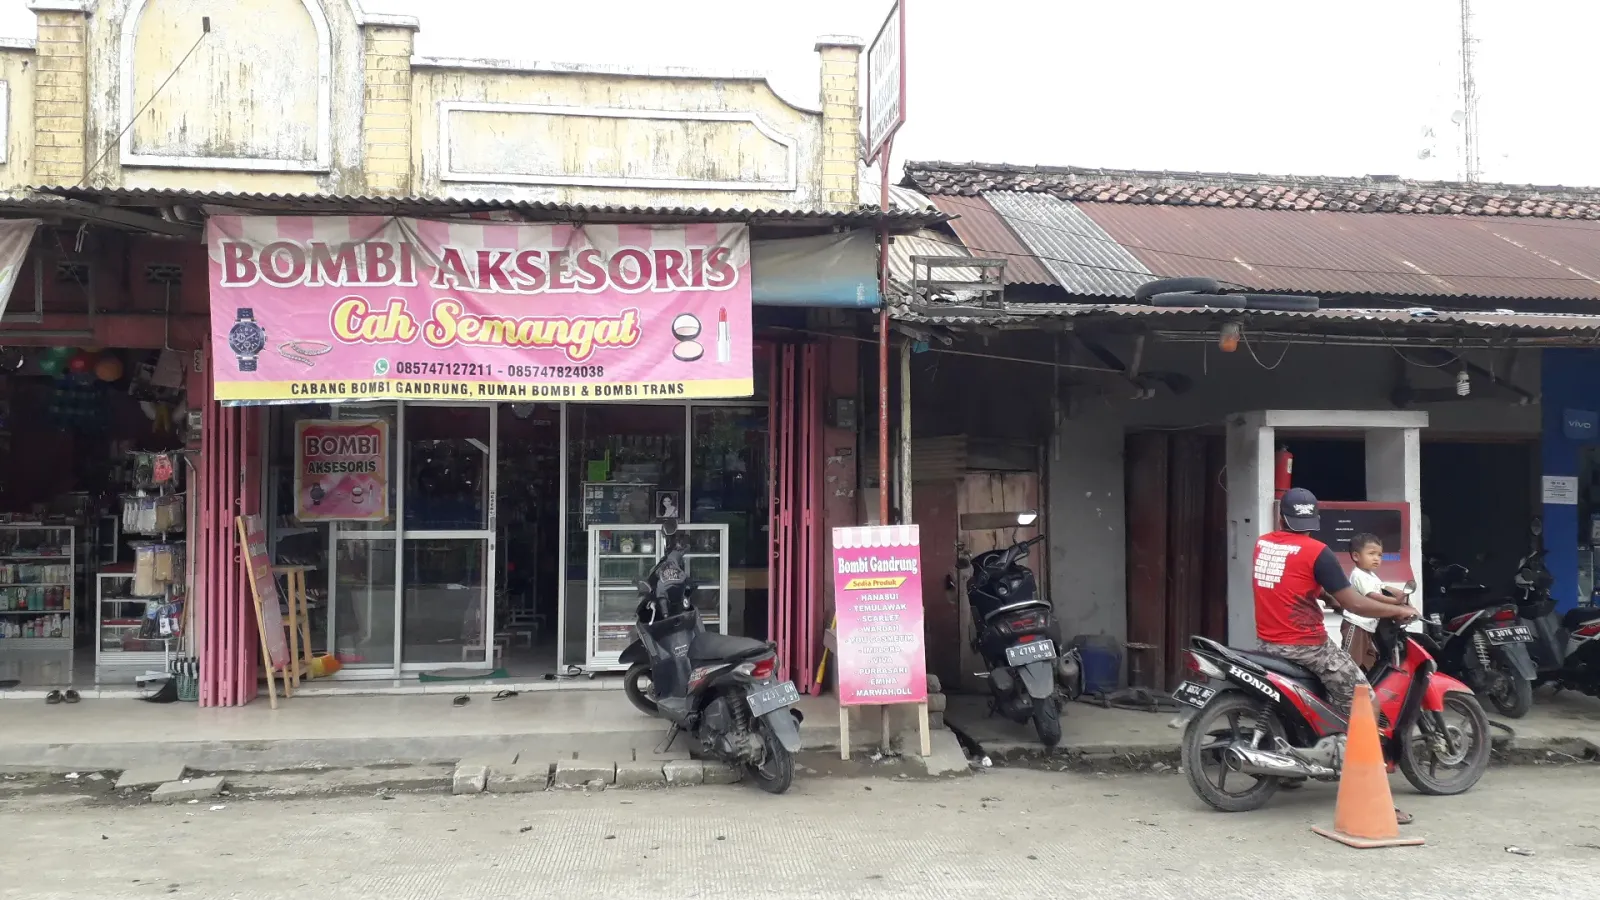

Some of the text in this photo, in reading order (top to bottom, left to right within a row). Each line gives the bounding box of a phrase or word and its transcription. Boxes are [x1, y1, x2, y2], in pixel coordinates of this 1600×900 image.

[221, 240, 738, 292] BOMBI AKSESORIS
[332, 297, 639, 360] Cah Semangat
[396, 362, 492, 376] 085747127211
[507, 364, 604, 378] 085747824038
[291, 382, 685, 397] CABANG BOMBI GANDRUNG, RUMAH BOMBI & BOMBI TRANS
[1568, 420, 1591, 429] vivo
[305, 434, 379, 457] BOMBI
[307, 460, 377, 474] AKSESORIS
[838, 556, 918, 575] Bombi Gandrung
[873, 579, 897, 587] Produk
[853, 603, 907, 612] TEMULAWAK
[862, 614, 899, 623] SCARLET
[1010, 649, 1016, 658] R
[1019, 645, 1036, 656] 4719
[1228, 664, 1281, 704] HONDA
[762, 689, 780, 702] 4231
